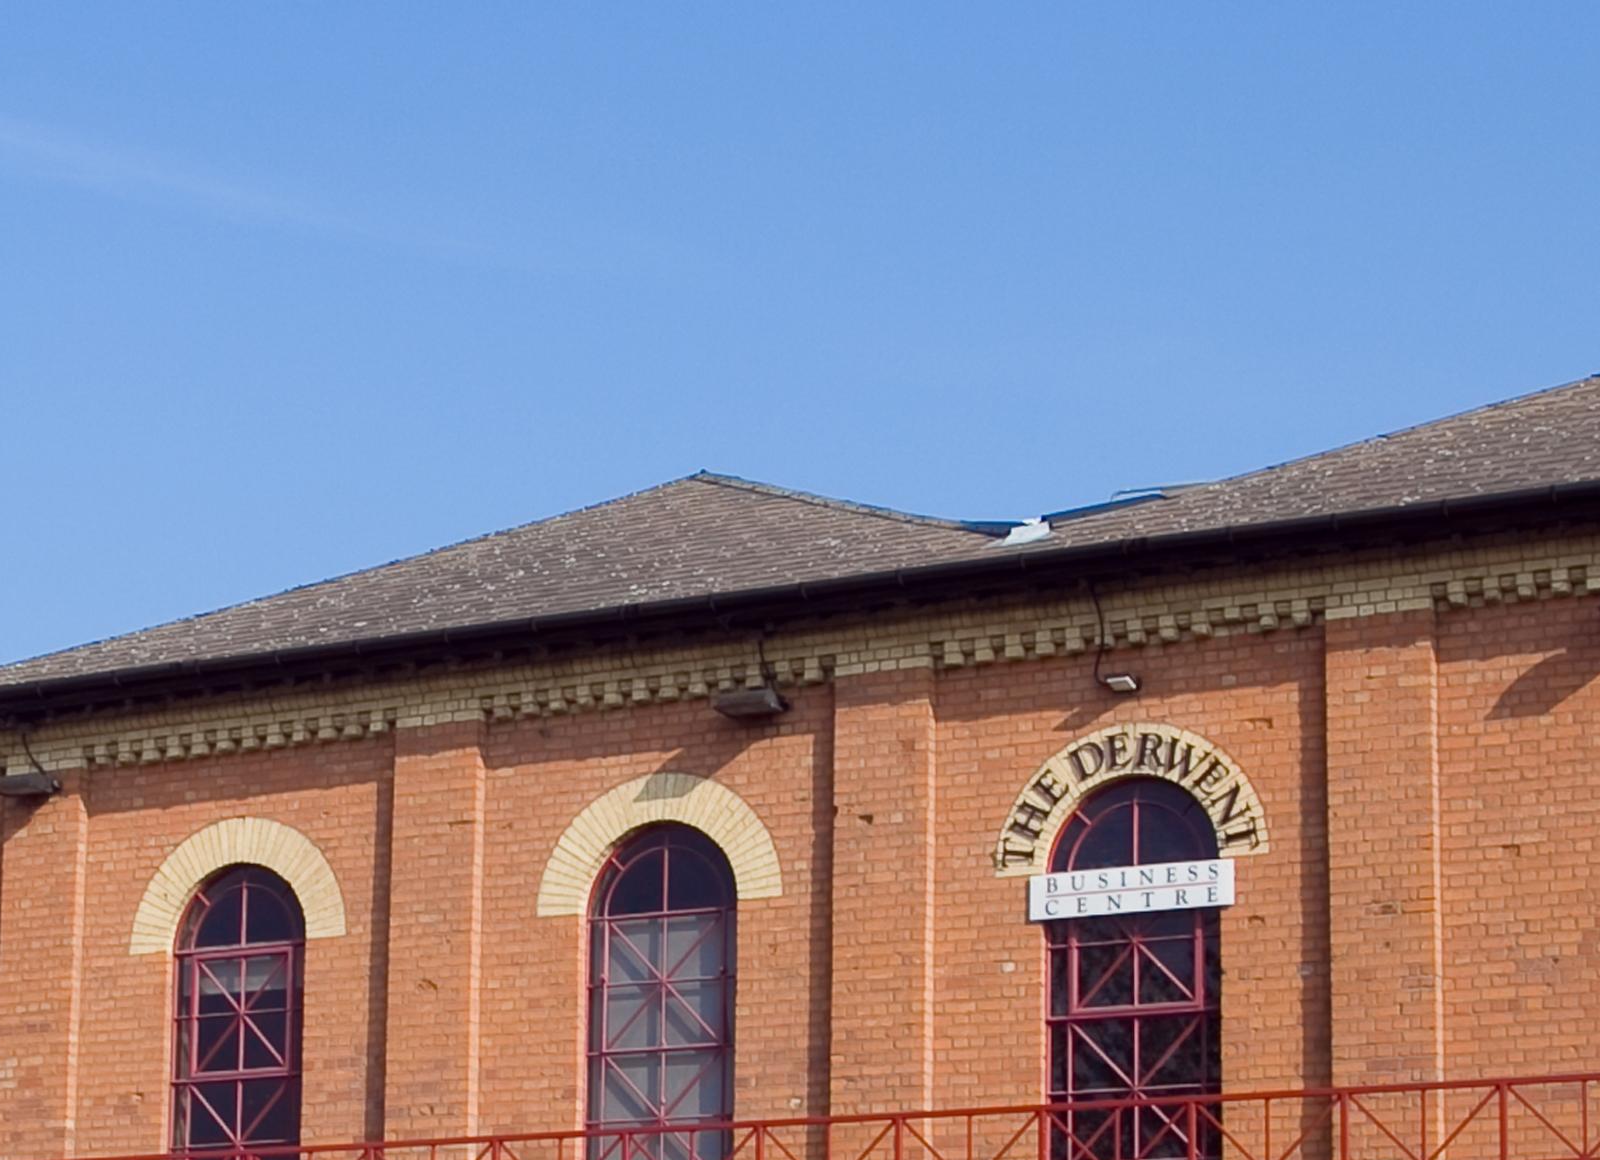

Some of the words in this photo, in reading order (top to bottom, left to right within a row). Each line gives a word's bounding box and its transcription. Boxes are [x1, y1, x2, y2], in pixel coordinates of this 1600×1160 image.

[997, 768, 1069, 868] THE
[1065, 732, 1260, 850] DERWENT
[1046, 864, 1219, 893] BUSINESS
[1045, 886, 1219, 915] CENTRE
